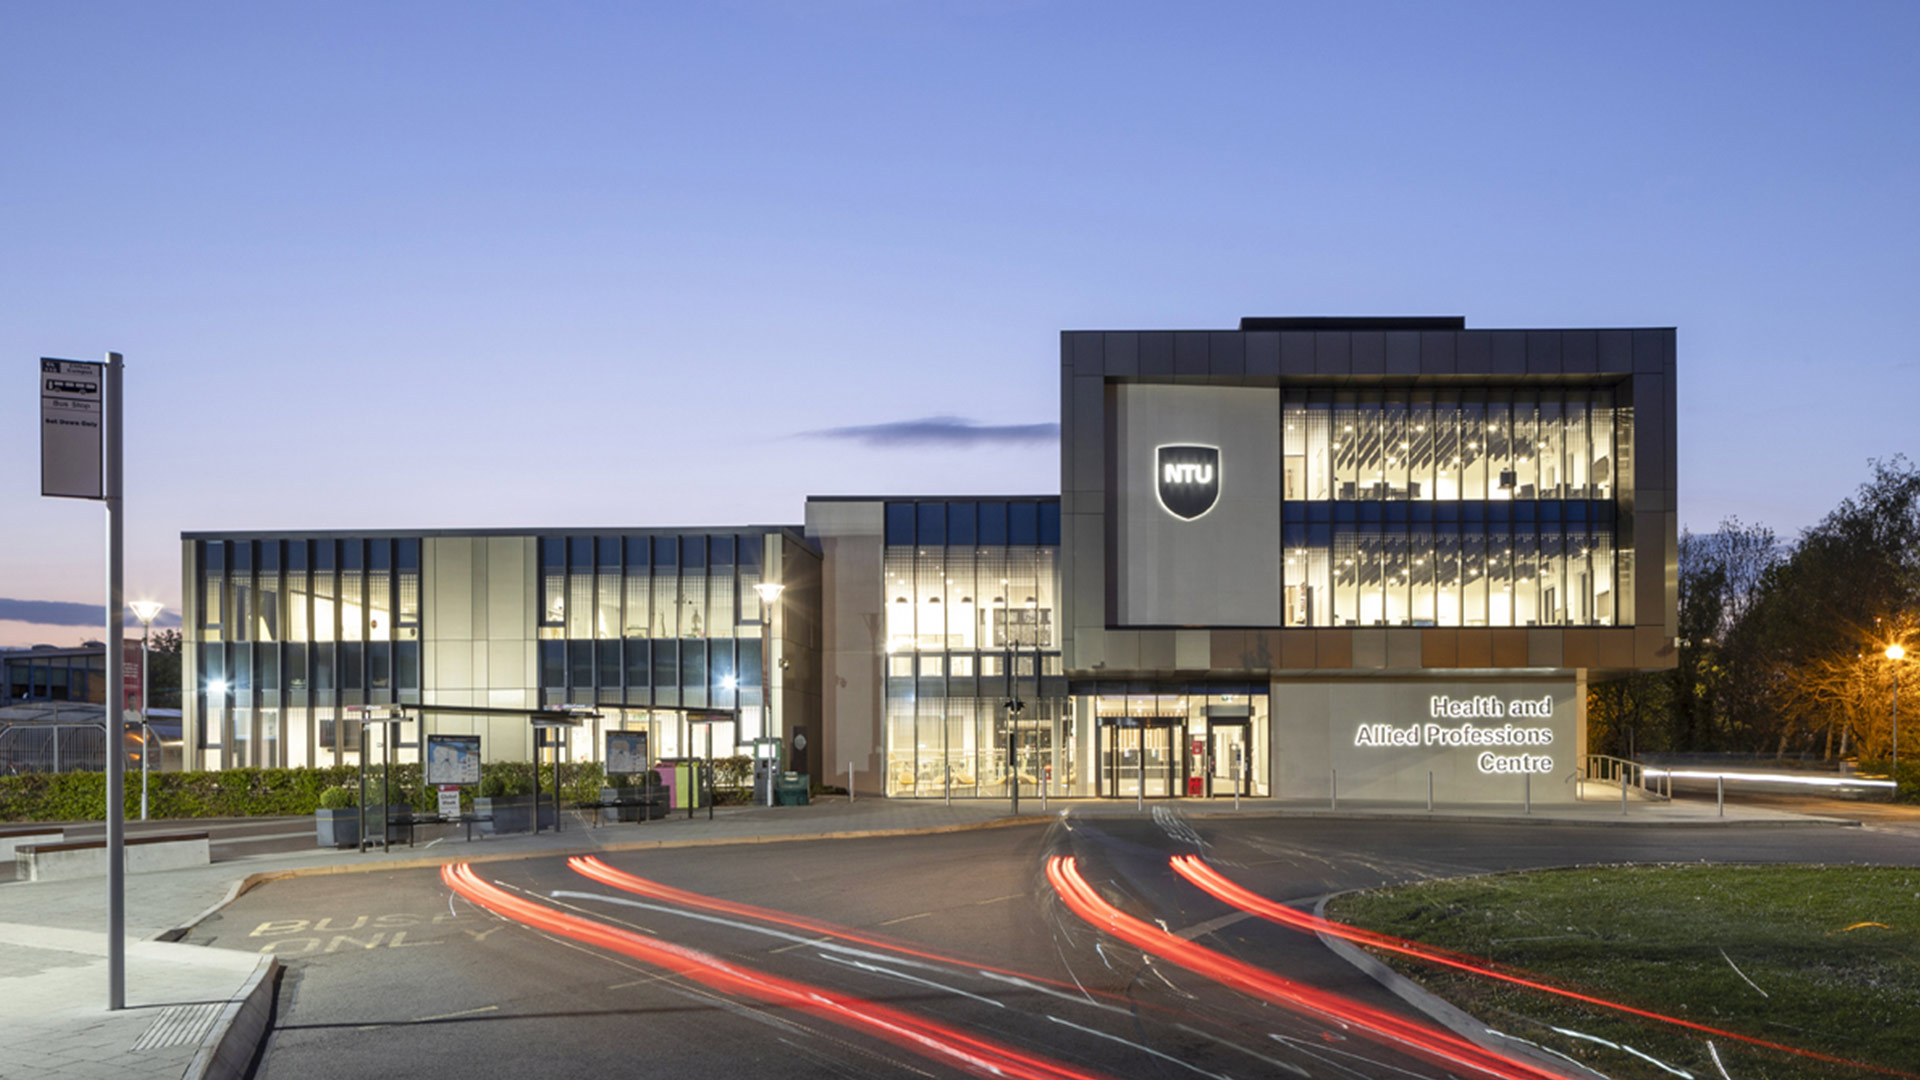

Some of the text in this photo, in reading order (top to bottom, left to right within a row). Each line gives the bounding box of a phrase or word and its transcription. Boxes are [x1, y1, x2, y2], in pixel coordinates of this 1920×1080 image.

[1164, 463, 1212, 484] NTU
[1431, 695, 1552, 717] Health and
[1355, 724, 1552, 746] Allied Professions
[1478, 752, 1552, 775] Centre
[257, 926, 504, 954] ONLY
